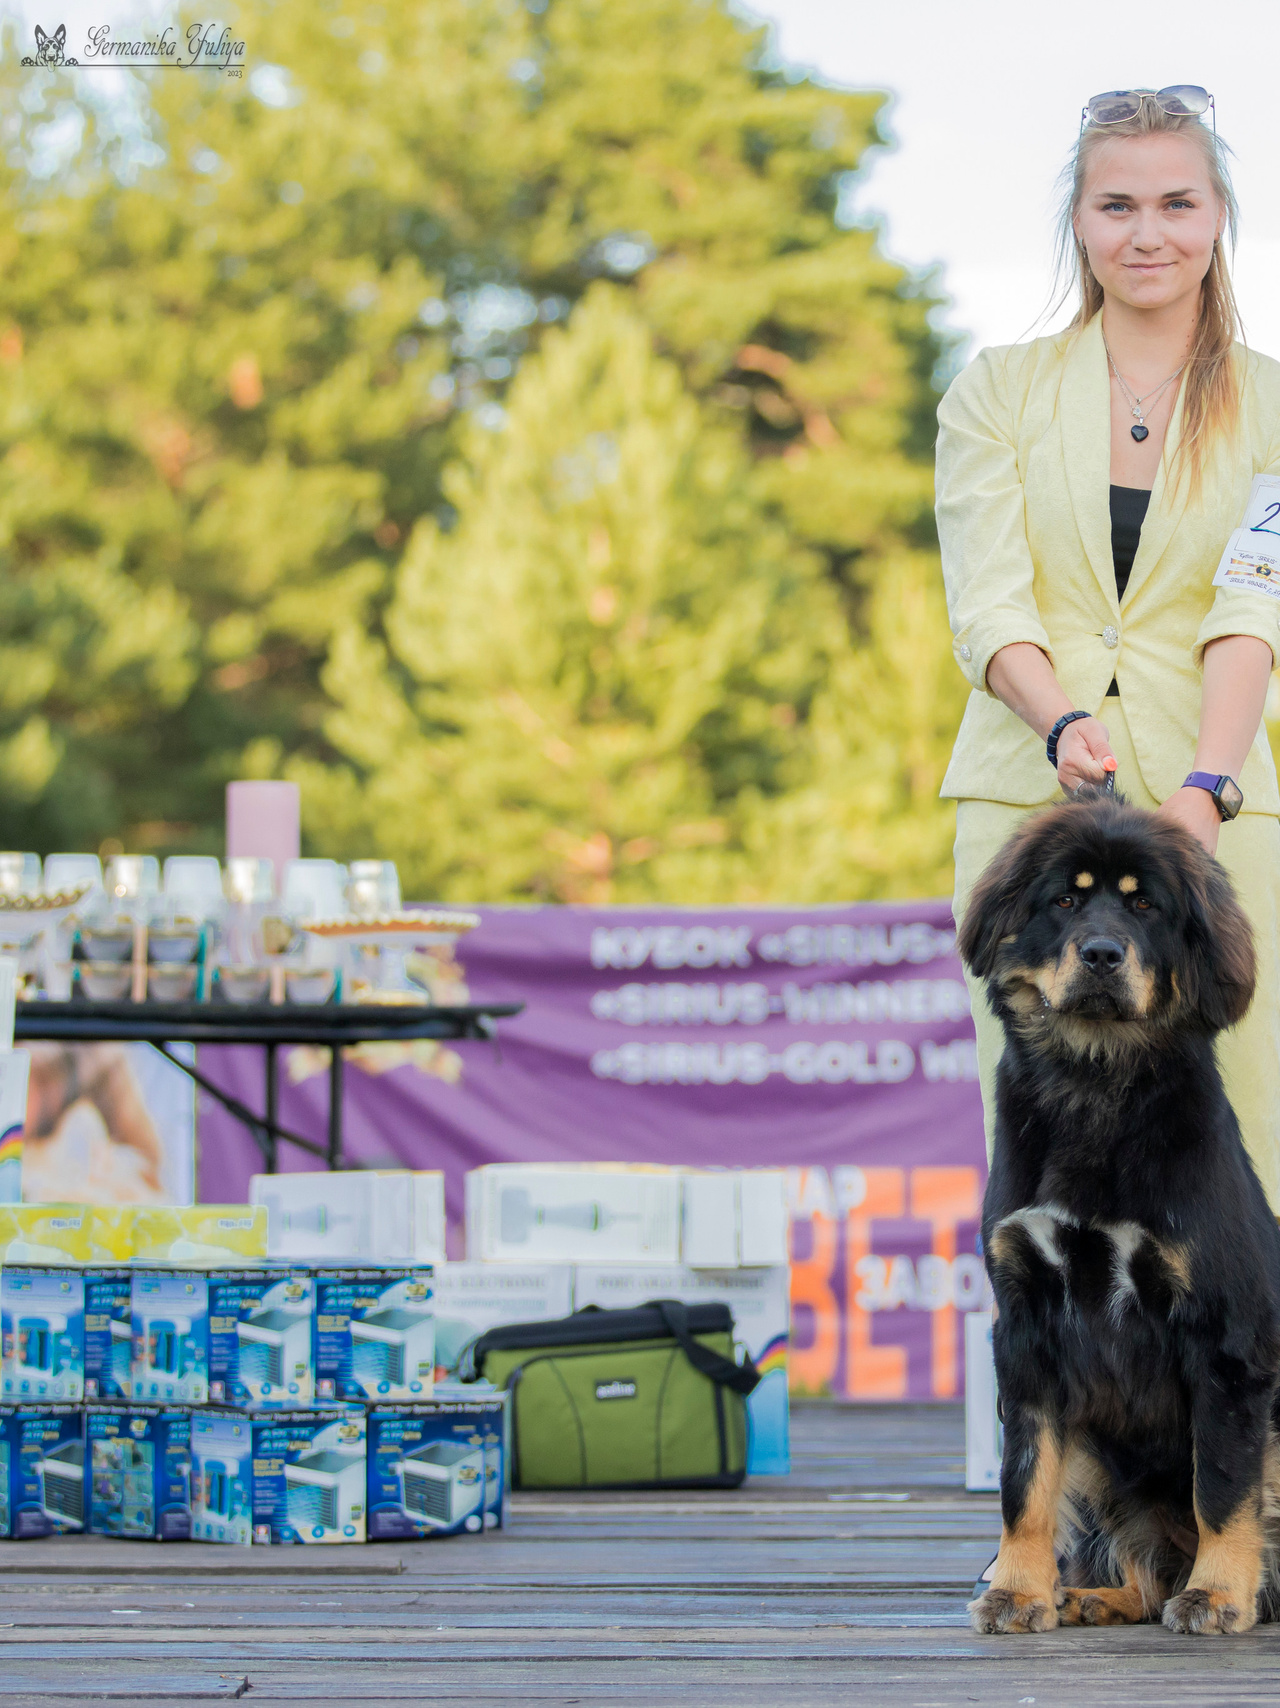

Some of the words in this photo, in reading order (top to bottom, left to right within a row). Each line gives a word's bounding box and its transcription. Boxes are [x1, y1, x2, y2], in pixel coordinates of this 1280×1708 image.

[590, 925, 753, 970] КУБОК
[589, 1040, 916, 1086] «SIRIUS-GOLD
[854, 1254, 992, 1313] ЗАВО
